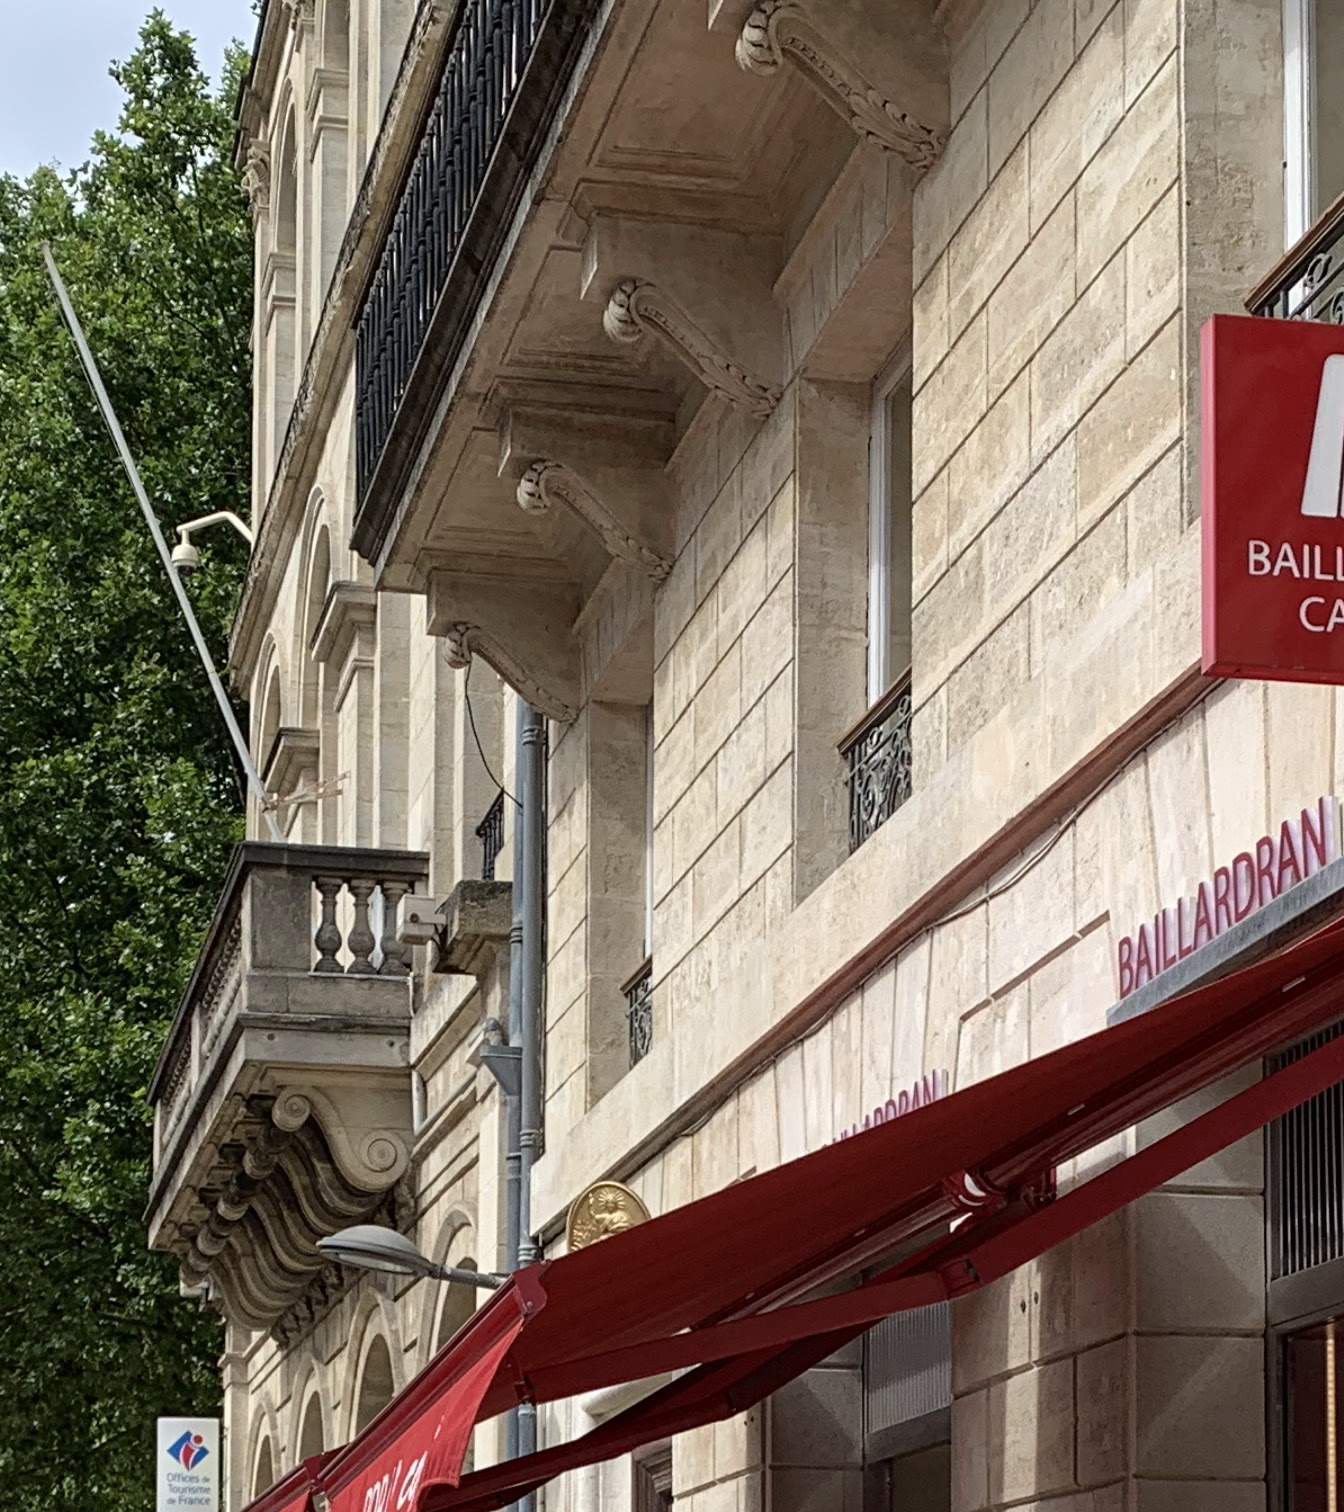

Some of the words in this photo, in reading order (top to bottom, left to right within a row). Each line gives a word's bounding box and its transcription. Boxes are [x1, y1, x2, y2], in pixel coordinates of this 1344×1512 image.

[1119, 796, 1334, 999] BAILLARDRAN
[167, 1472, 199, 1483] Offices
[168, 1484, 210, 1494] Tourisme
[178, 1496, 211, 1505] France
